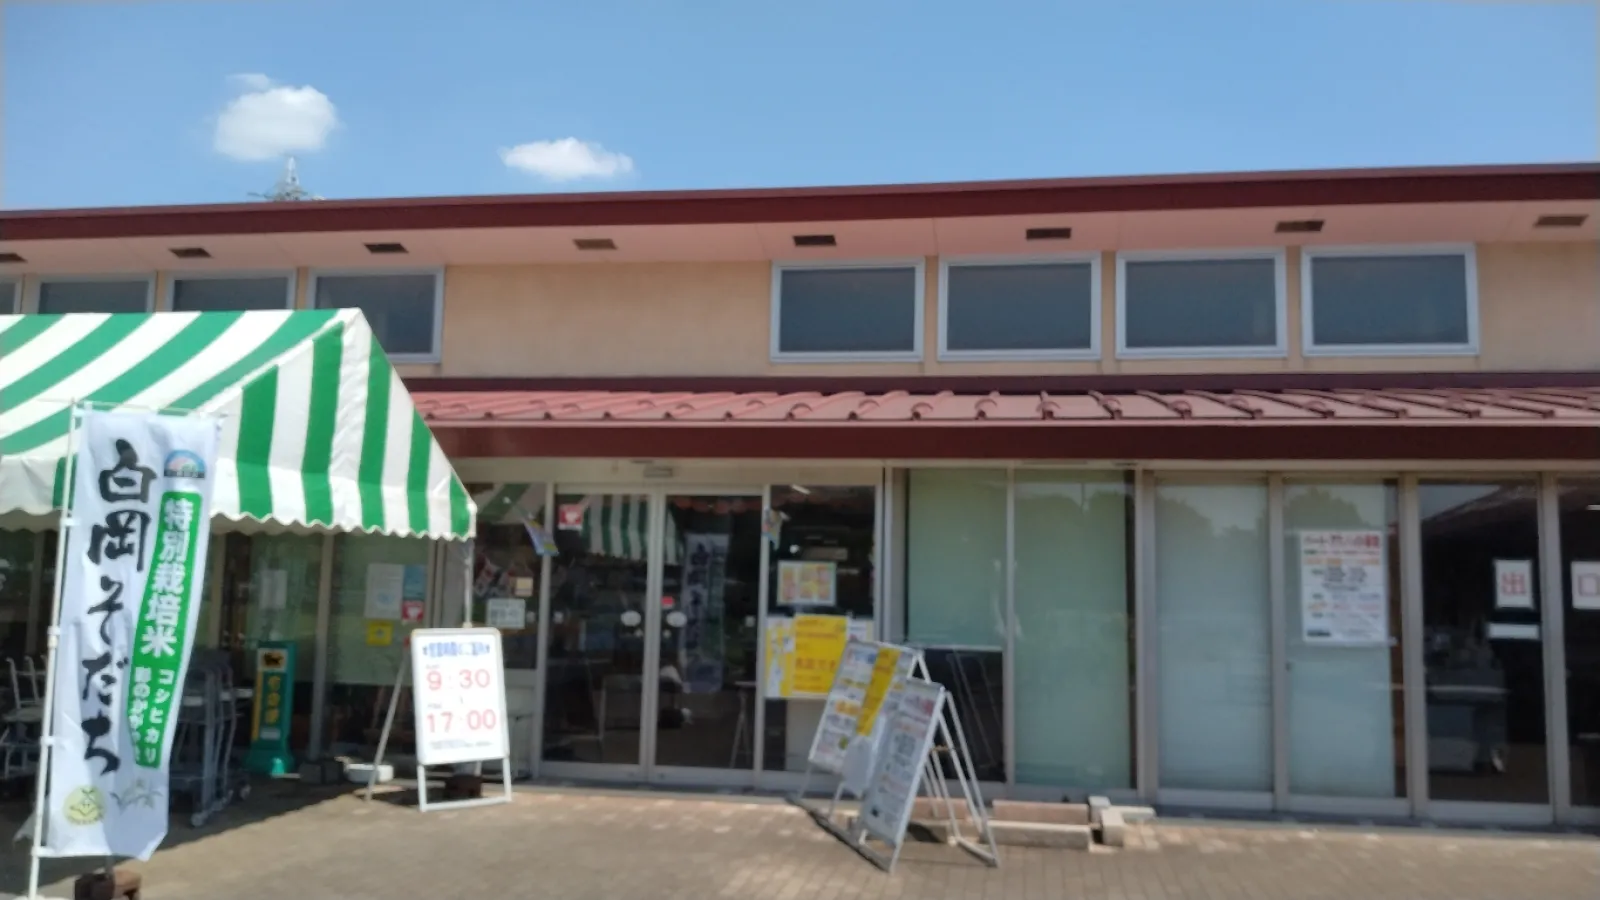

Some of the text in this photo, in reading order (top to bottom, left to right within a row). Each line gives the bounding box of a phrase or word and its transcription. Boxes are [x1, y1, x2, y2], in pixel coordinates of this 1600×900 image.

[82, 438, 156, 776] 白岡そだち
[141, 497, 194, 658] 特別栽培米
[1501, 571, 1527, 596] 出
[144, 668, 175, 764] コシヒカリ
